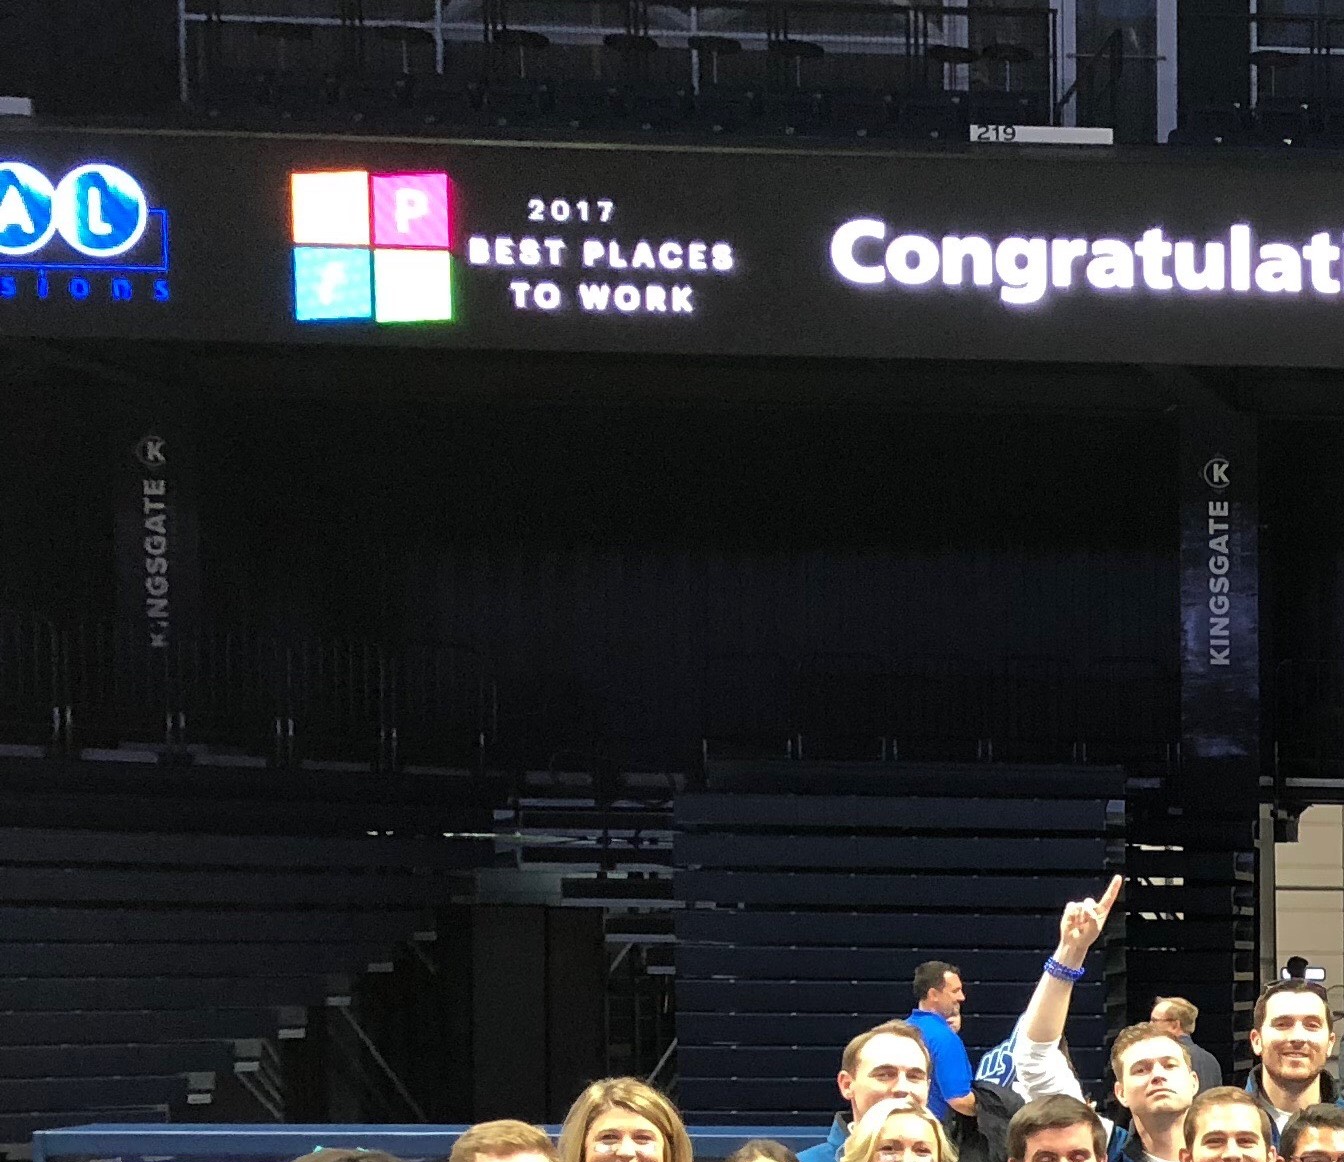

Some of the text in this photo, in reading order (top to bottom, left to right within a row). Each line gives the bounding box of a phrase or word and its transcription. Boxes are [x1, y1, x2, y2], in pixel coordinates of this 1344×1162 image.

[977, 124, 1016, 141] 219
[527, 199, 615, 222] 2017
[467, 235, 735, 270] BEST PLACES
[509, 280, 695, 313] TO WORK
[1208, 501, 1230, 665] KINGSGATE
